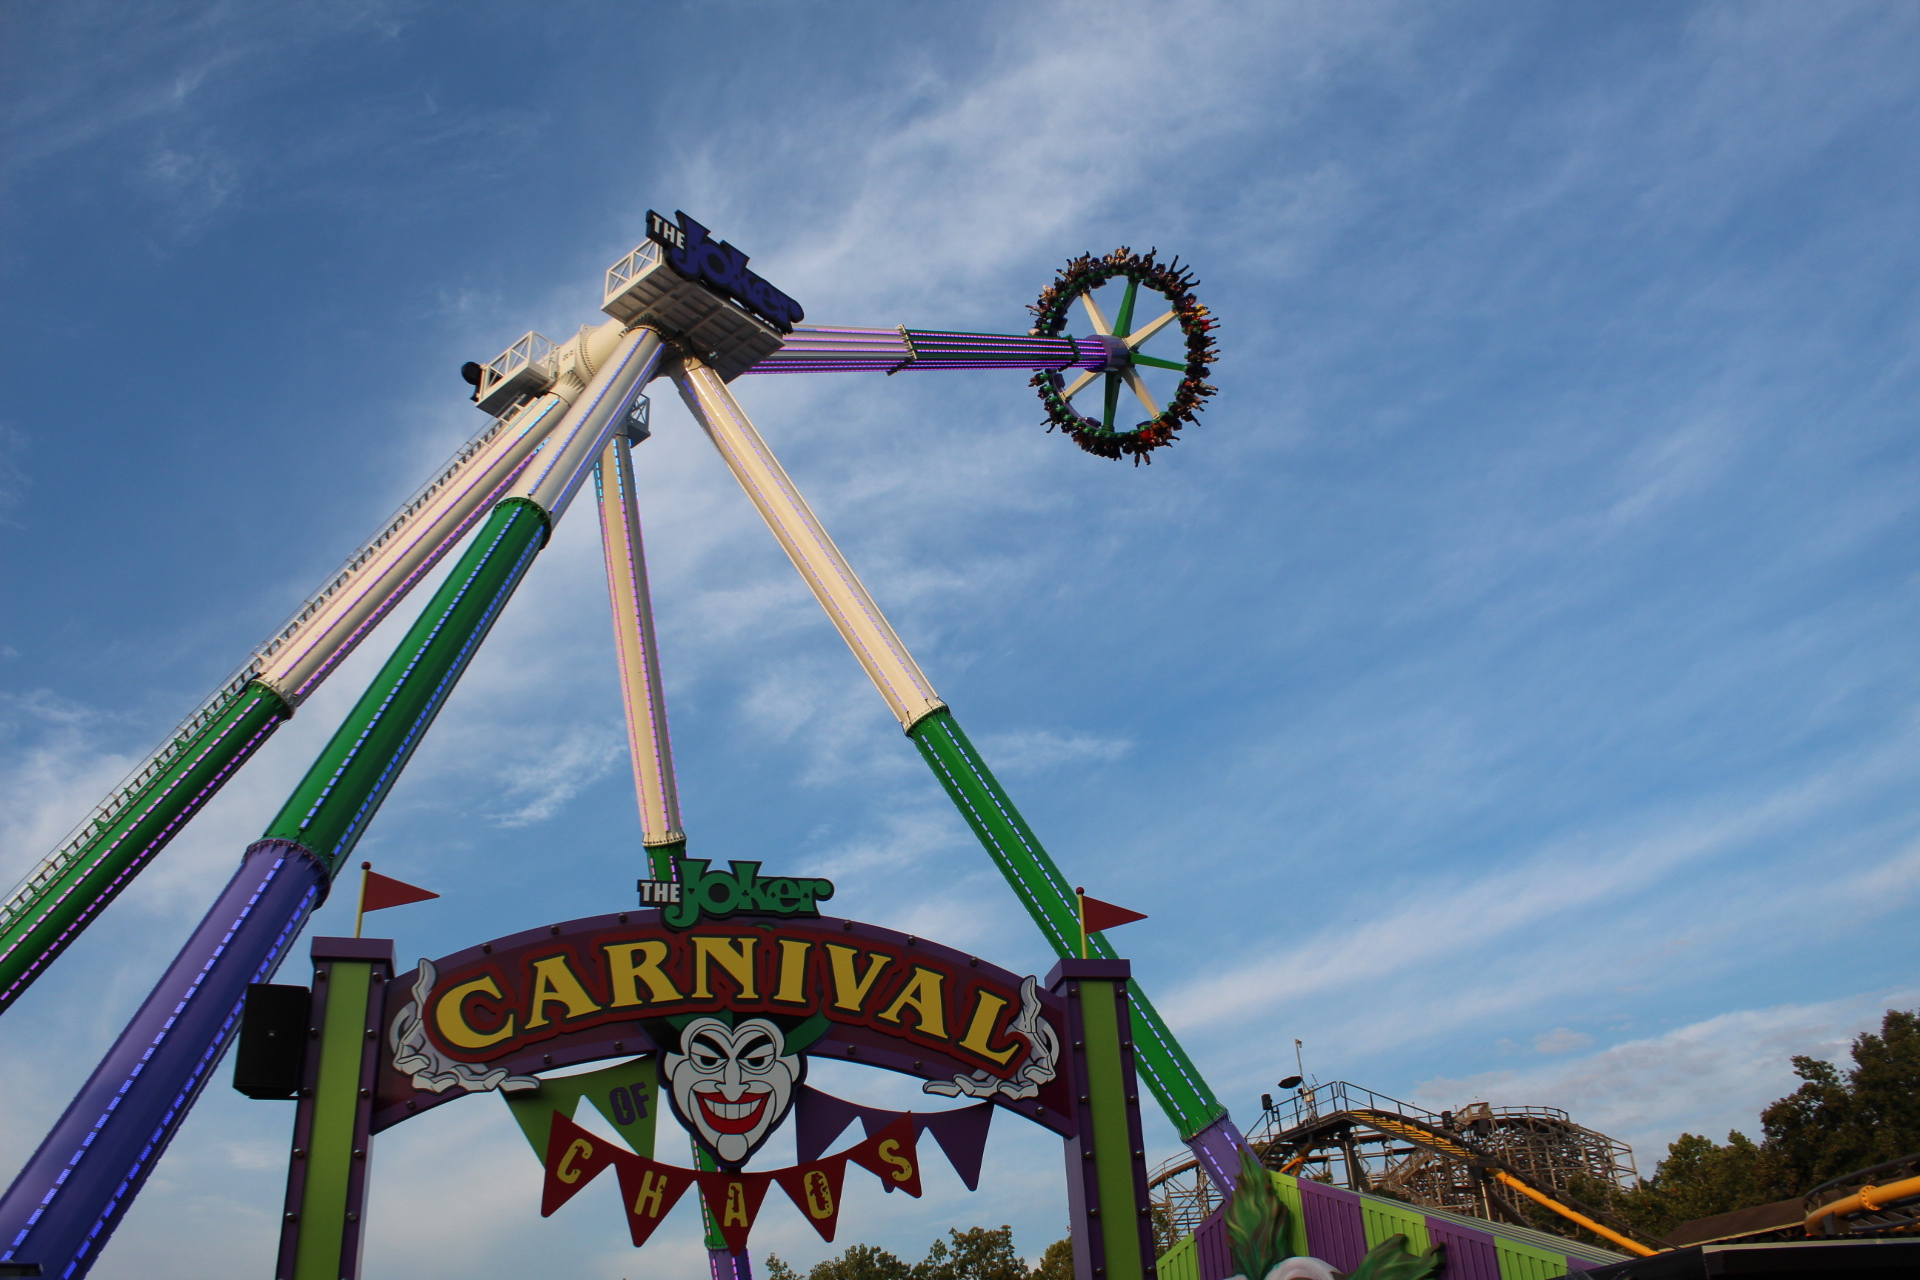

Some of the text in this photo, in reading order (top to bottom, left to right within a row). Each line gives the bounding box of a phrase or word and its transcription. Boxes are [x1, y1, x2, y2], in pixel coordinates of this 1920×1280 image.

[653, 214, 802, 330] THE Joker
[640, 860, 832, 928] THE Joker
[435, 937, 1022, 1064] CARNIVAL
[609, 1082, 650, 1126] OF
[556, 1137, 913, 1228] CHAOS
